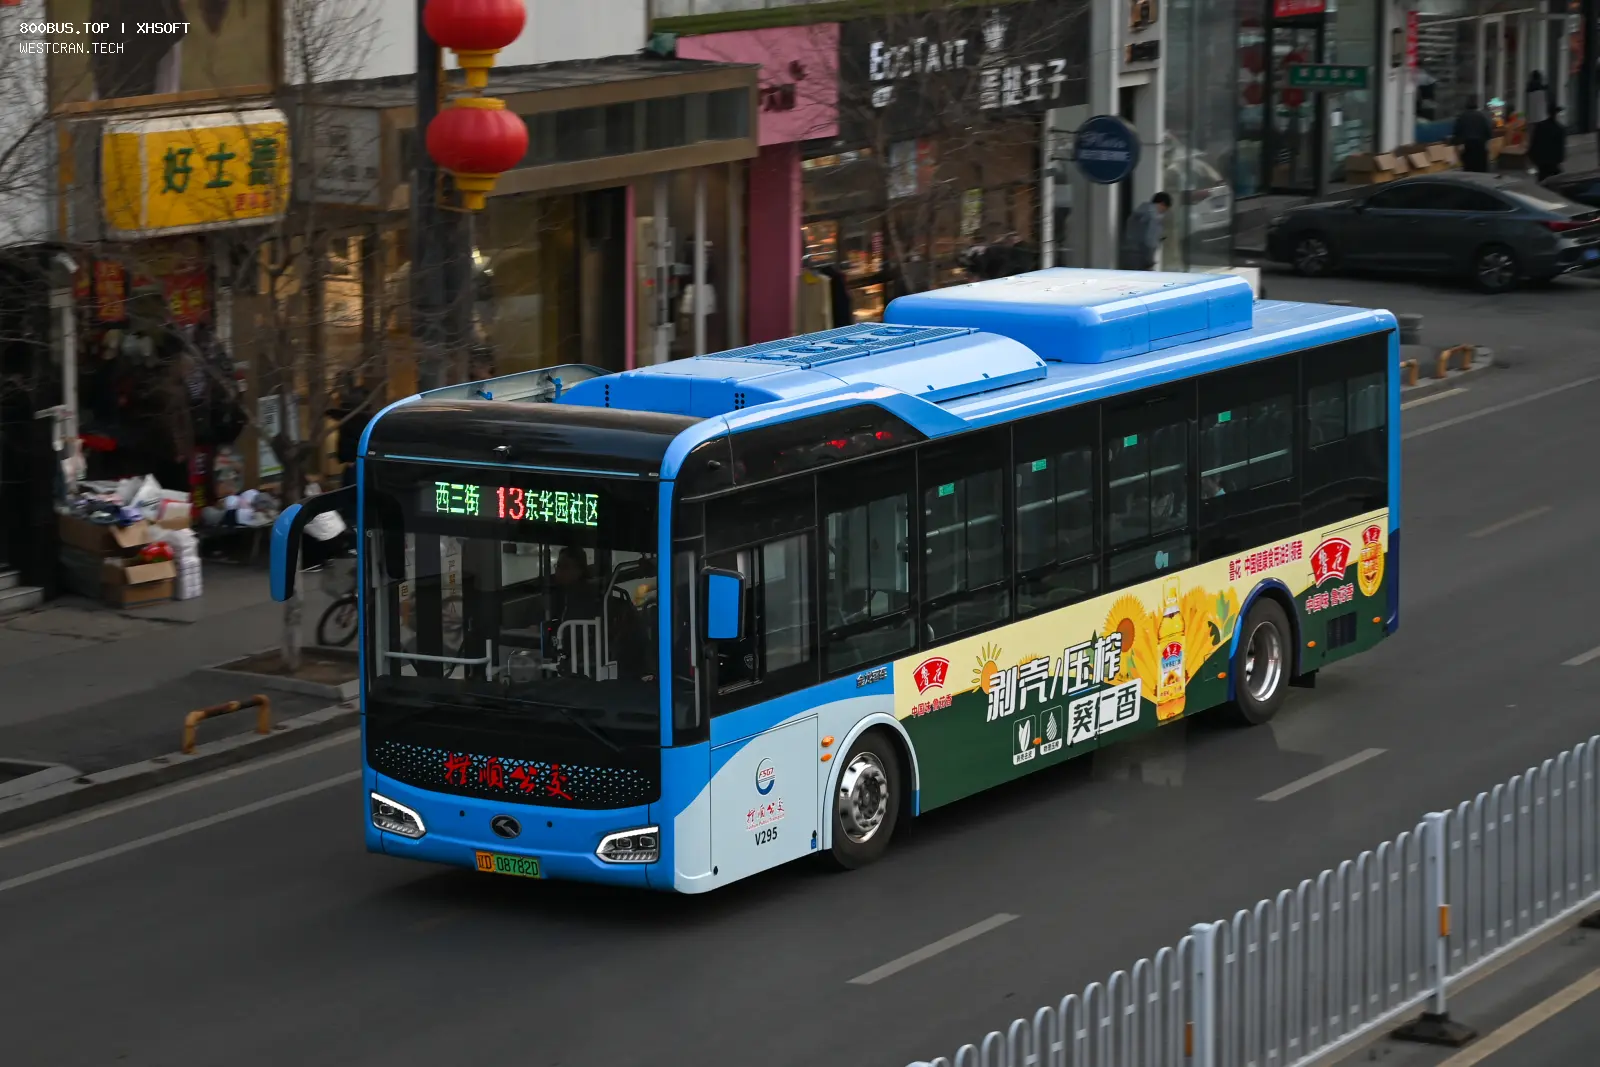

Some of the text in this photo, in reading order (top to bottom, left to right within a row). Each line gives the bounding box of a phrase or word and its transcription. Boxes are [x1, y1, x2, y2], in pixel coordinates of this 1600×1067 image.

[435, 481, 599, 526] 西三街 13 东华园社区
[1071, 683, 1138, 738] 葵仁香
[755, 826, 778, 846] V295
